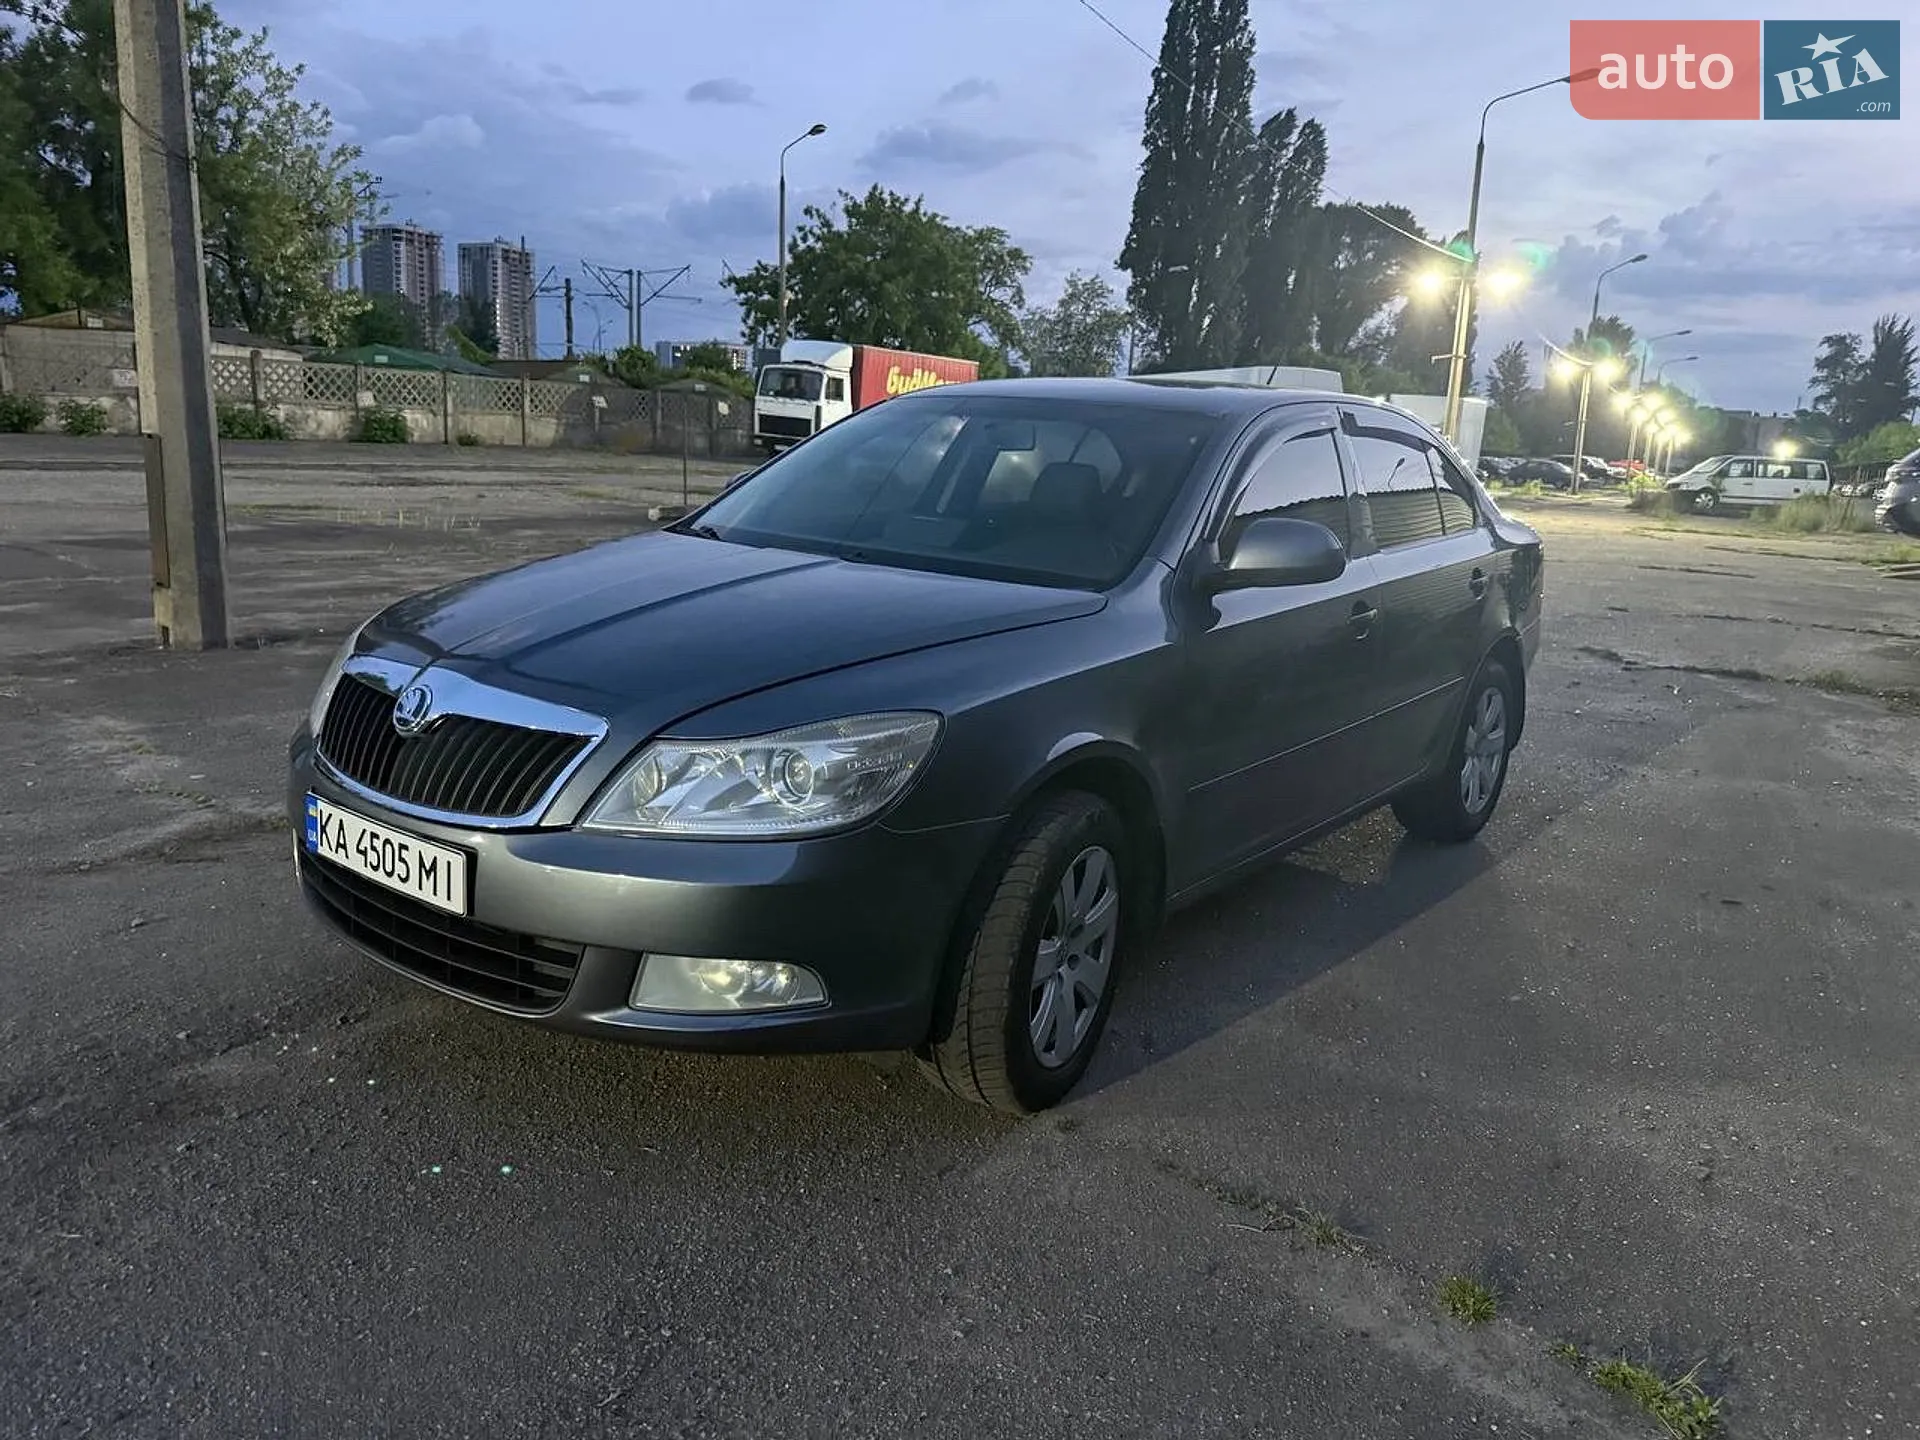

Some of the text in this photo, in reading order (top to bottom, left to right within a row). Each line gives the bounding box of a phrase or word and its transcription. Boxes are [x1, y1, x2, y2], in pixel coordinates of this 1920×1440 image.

[319, 808, 452, 902] KA 4505 MI
